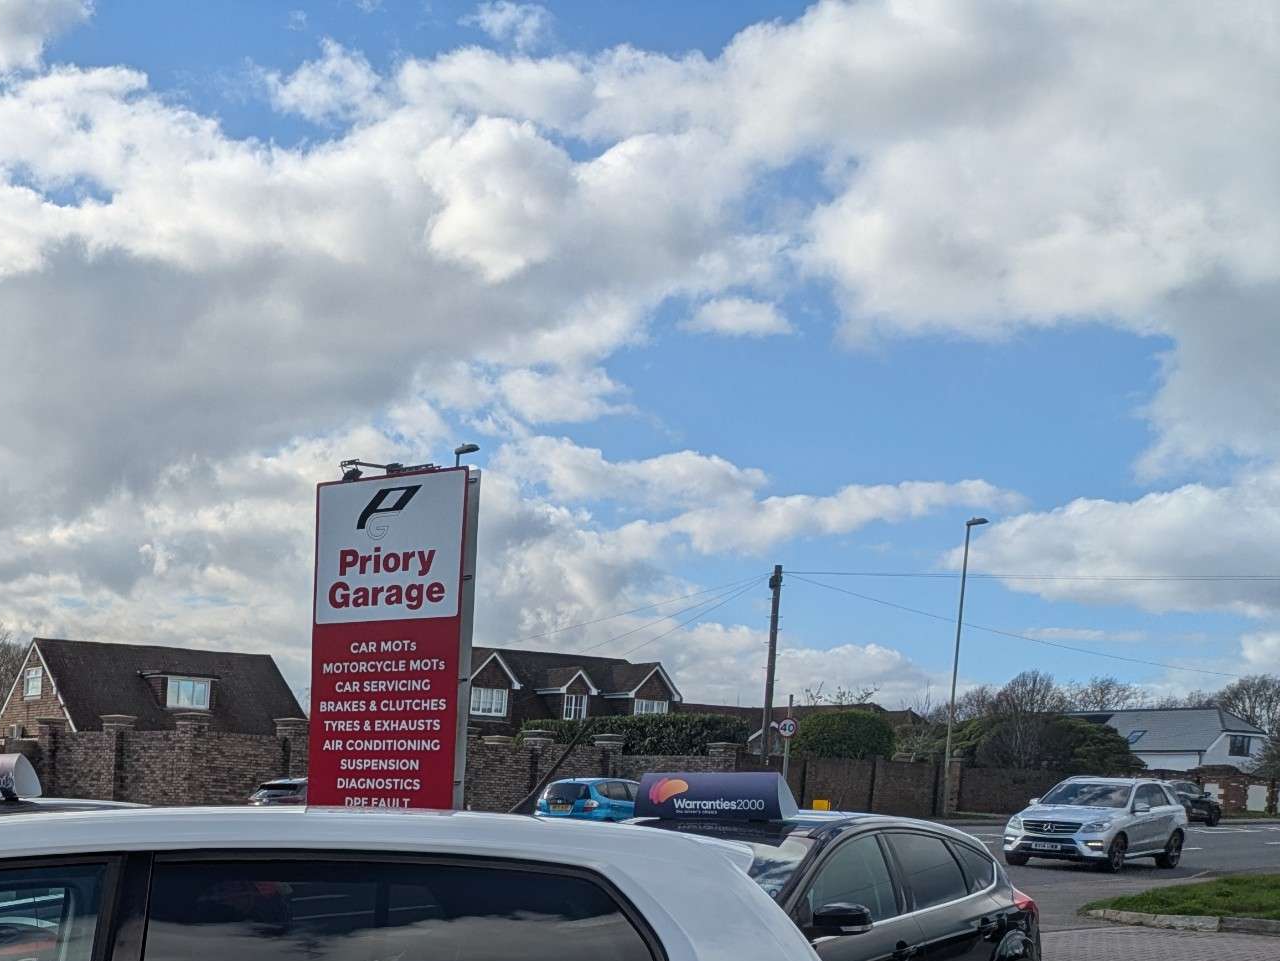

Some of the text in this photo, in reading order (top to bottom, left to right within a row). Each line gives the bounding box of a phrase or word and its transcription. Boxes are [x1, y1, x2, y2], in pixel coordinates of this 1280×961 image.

[339, 546, 437, 577] Priory
[328, 581, 446, 611] Garage
[350, 640, 417, 653] CAR MOTs
[322, 658, 446, 674] MOTORCYCLE MOTs
[335, 679, 431, 693] CAR SERVICING
[319, 699, 447, 712] BRAKES & CLUTCHES
[324, 719, 441, 731] TYRES & EXHAUSTS
[780, 723, 795, 733] 40
[322, 739, 441, 751] AIR CONDITIONING
[340, 759, 420, 770] SUSPENSION
[336, 778, 421, 790] DIAGNOSTICS
[344, 797, 368, 808] DPF
[673, 797, 765, 810] Warranties2000
